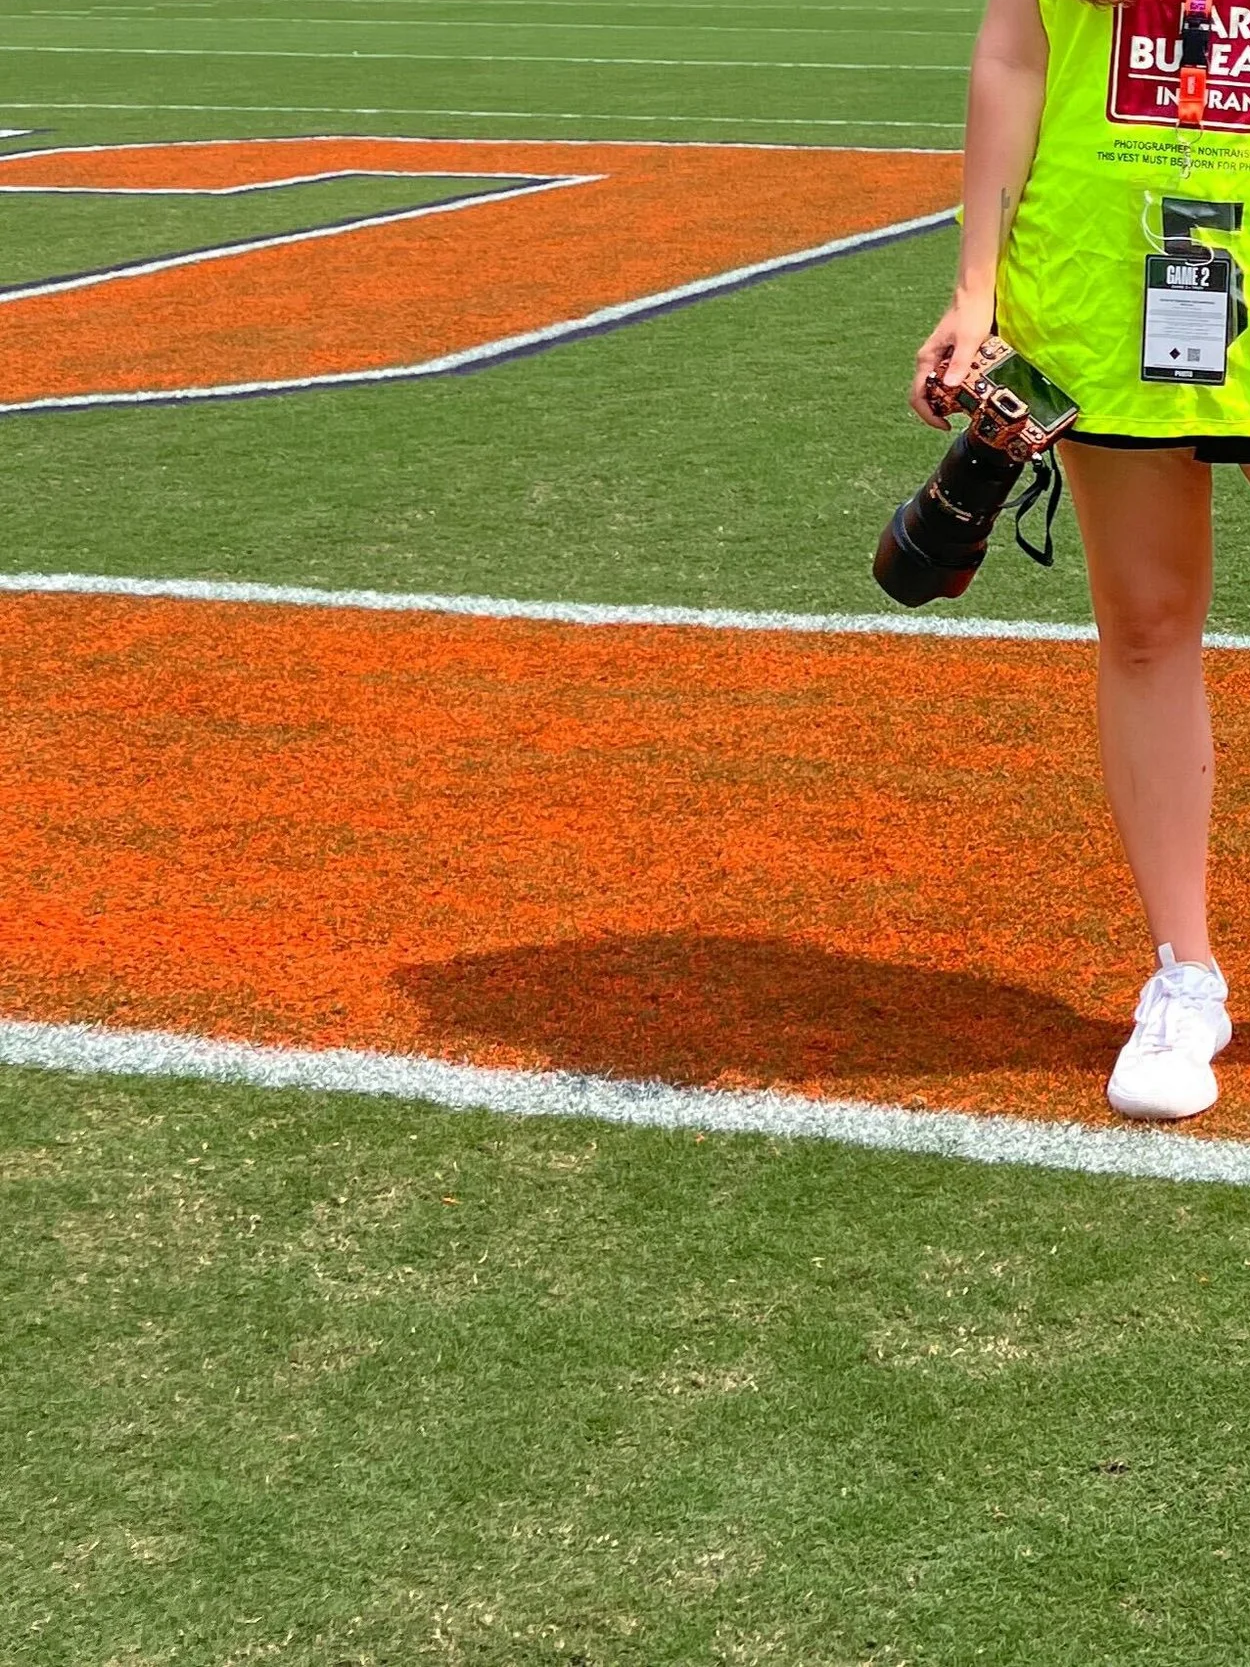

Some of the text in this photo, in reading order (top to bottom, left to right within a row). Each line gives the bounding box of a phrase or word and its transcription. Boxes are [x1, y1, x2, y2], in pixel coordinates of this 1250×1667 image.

[1097, 151, 1115, 161] THIS
[1117, 153, 1139, 163] VEST
[1142, 155, 1167, 166] MUST
[1217, 162, 1236, 171] FOR
[1166, 265, 1210, 287] GAME 2
